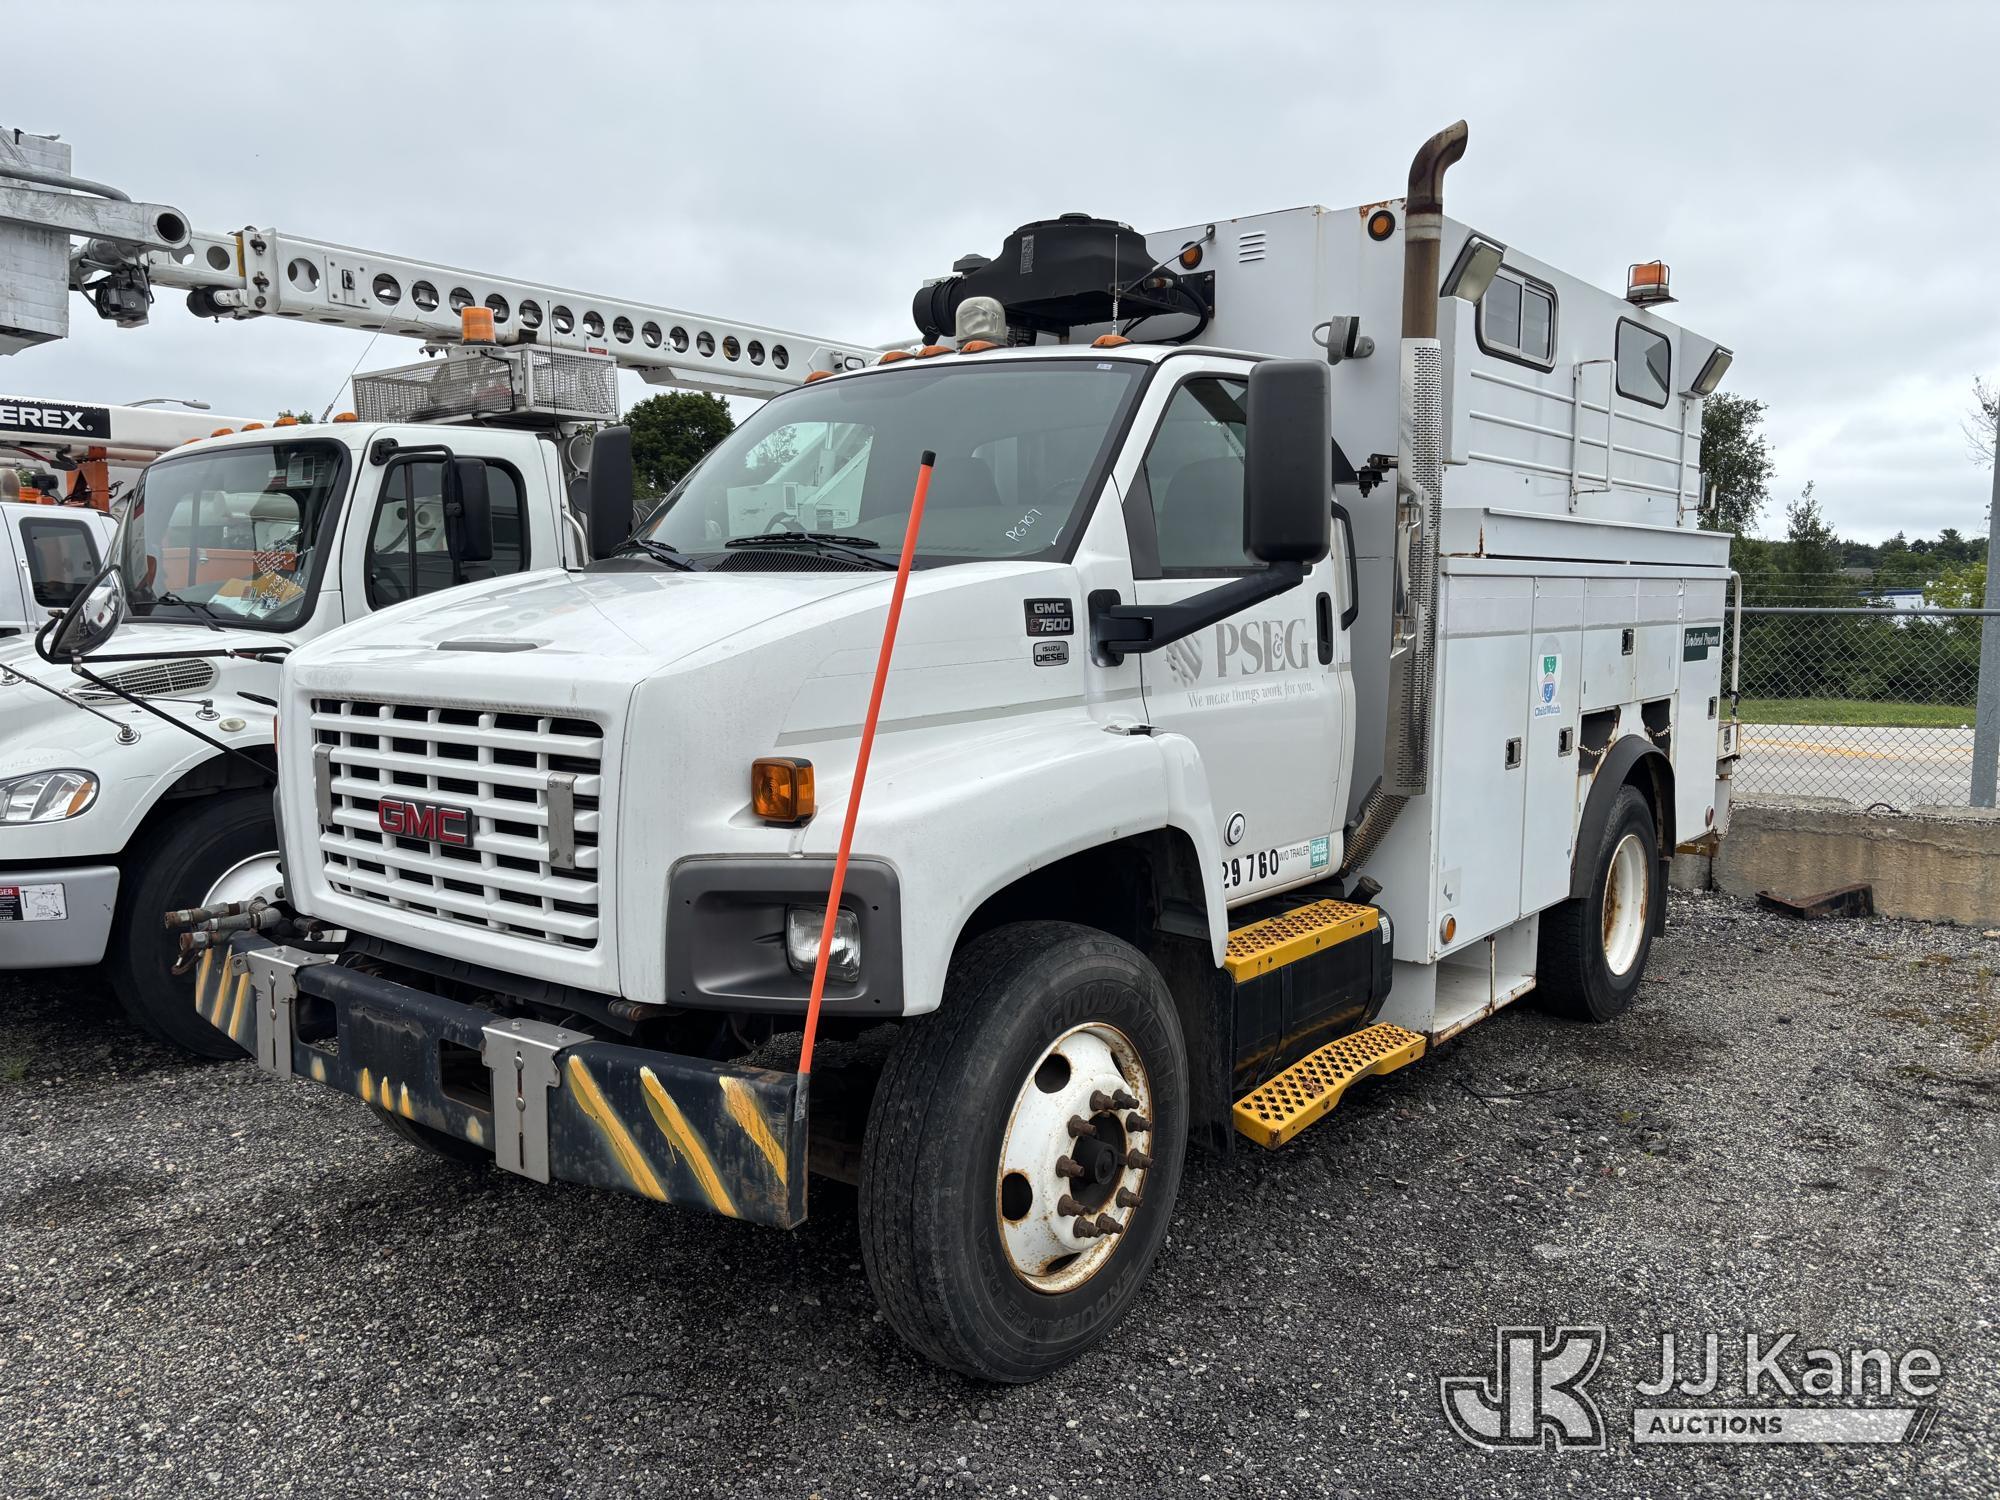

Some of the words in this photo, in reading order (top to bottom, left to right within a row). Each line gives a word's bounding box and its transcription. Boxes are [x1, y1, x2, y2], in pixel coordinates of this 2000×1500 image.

[1034, 602, 1065, 614] GMC
[1029, 617, 1071, 632] C7500
[1035, 653, 1068, 662] DIESEL
[1187, 691, 1204, 709] We
[1205, 692, 1231, 706] make
[1232, 685, 1261, 704] things
[378, 798, 467, 846] GMC
[1246, 848, 1279, 882] 760
